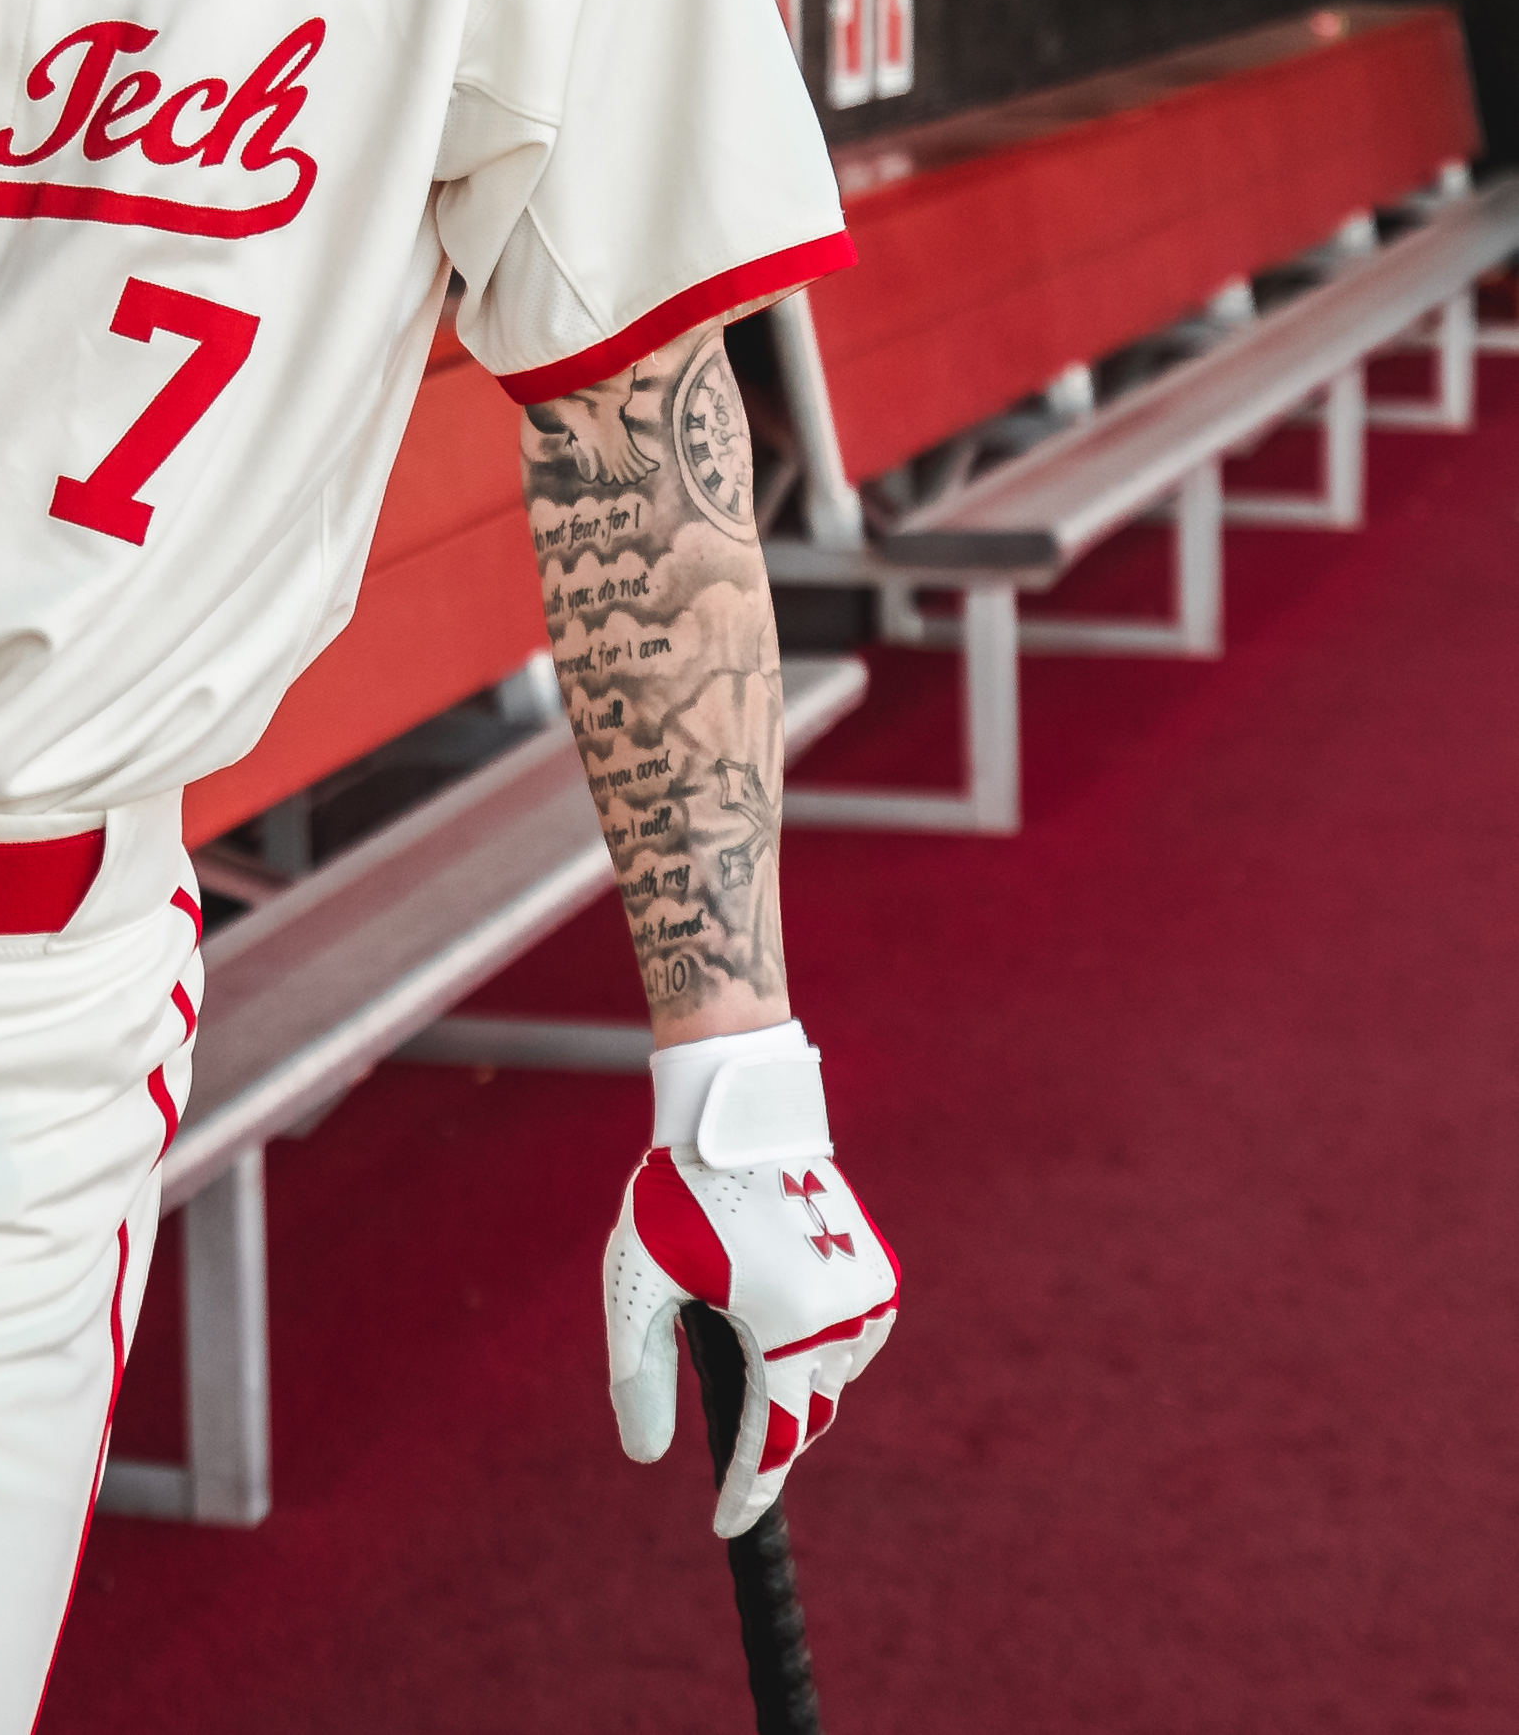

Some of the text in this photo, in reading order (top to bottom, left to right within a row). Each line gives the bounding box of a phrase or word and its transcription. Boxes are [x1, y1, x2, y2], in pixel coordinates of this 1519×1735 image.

[47, 275, 262, 548] 7
[545, 519, 568, 547] not
[605, 506, 630, 547] for
[634, 501, 641, 528] I
[597, 578, 617, 603] do
[619, 570, 650, 597] not
[598, 639, 622, 673] for
[627, 637, 633, 660] I
[639, 637, 672, 660] am
[597, 699, 625, 730] will
[607, 769, 634, 796] you
[636, 748, 673, 781] and
[631, 817, 636, 840] I
[640, 805, 673, 839] will
[662, 864, 691, 897] my
